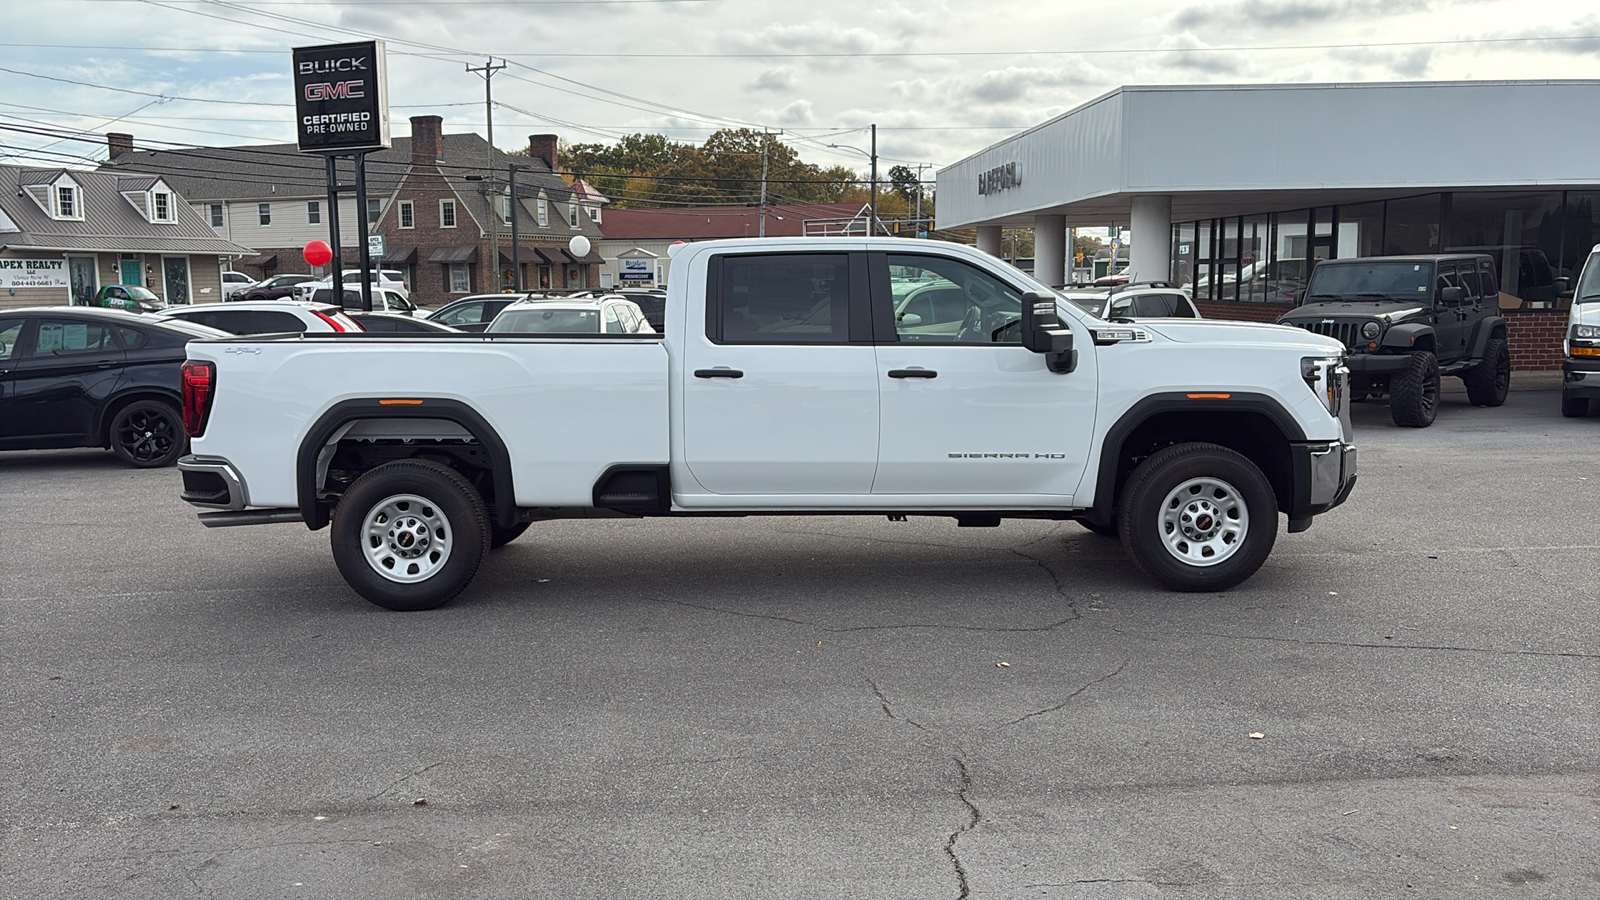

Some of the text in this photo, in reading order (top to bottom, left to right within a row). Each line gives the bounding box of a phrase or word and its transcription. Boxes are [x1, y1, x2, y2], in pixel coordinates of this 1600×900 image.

[299, 57, 367, 74] BUICK
[305, 80, 364, 101] GMC
[303, 112, 370, 125] CERTIFIED
[307, 122, 367, 134] PRE-OWNED
[0, 261, 62, 269] APEX REALTY
